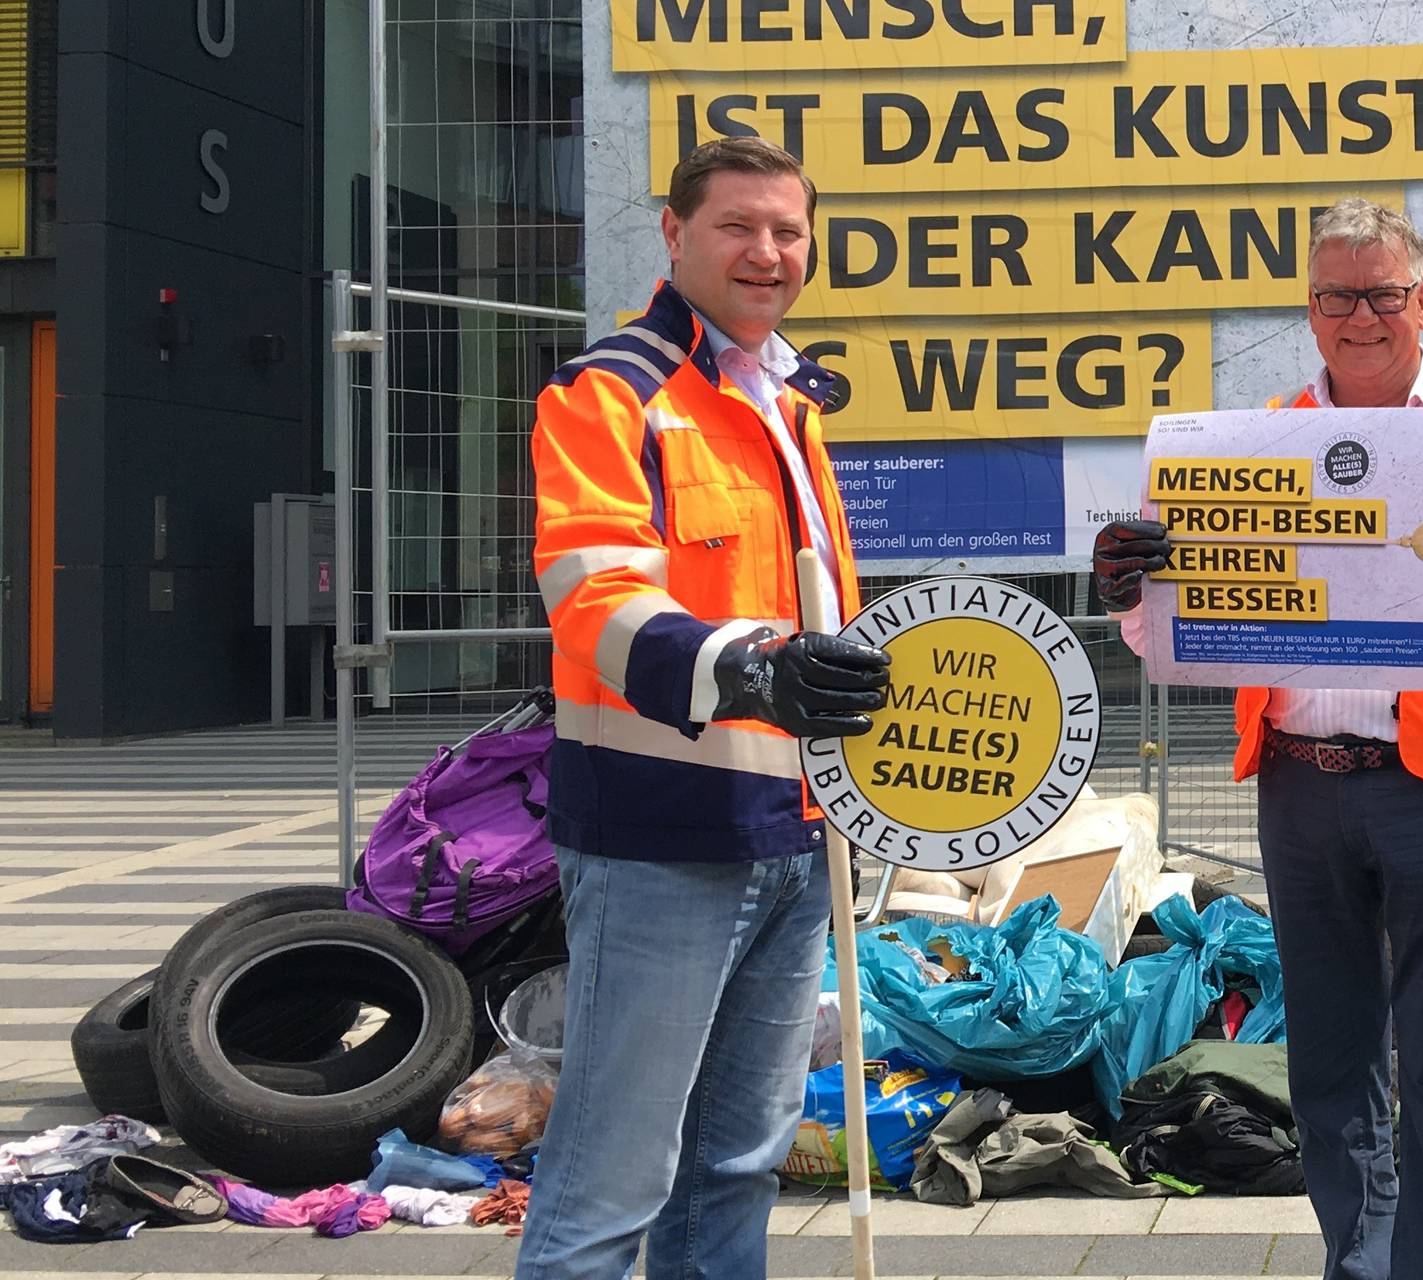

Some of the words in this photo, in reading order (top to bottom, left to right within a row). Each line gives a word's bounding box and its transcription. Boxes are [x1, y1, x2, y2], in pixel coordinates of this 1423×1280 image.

[862, 88, 1070, 165] DAS
[803, 214, 1032, 289] DER
[1074, 206, 1337, 285] KAN
[891, 333, 1186, 413] WEG?
[874, 456, 944, 471] sauberer:
[1330, 453, 1362, 463] MACHEN
[1338, 446, 1353, 454] WIR
[1332, 461, 1362, 471] ALLE(S)
[1332, 469, 1363, 480] SAUBER
[874, 476, 897, 490] Tür
[1157, 467, 1306, 496] MENSCH,
[842, 496, 888, 510] sauber
[849, 516, 889, 529] Freien
[1167, 507, 1377, 535] PROFI-BESEN
[911, 536, 933, 548] um
[937, 532, 964, 547] den
[969, 531, 1018, 550] großen
[1023, 532, 1052, 545] Rest
[1186, 586, 1317, 613] BESSER!
[855, 585, 1075, 663] INITIATIVE
[1309, 635, 1323, 644] FÜR
[932, 648, 998, 681] WIR
[885, 683, 1032, 722] MACHEN
[877, 722, 1020, 764] ALLE(S)
[871, 759, 1016, 797] SAUBER
[947, 691, 1094, 864] SOLINGEN
